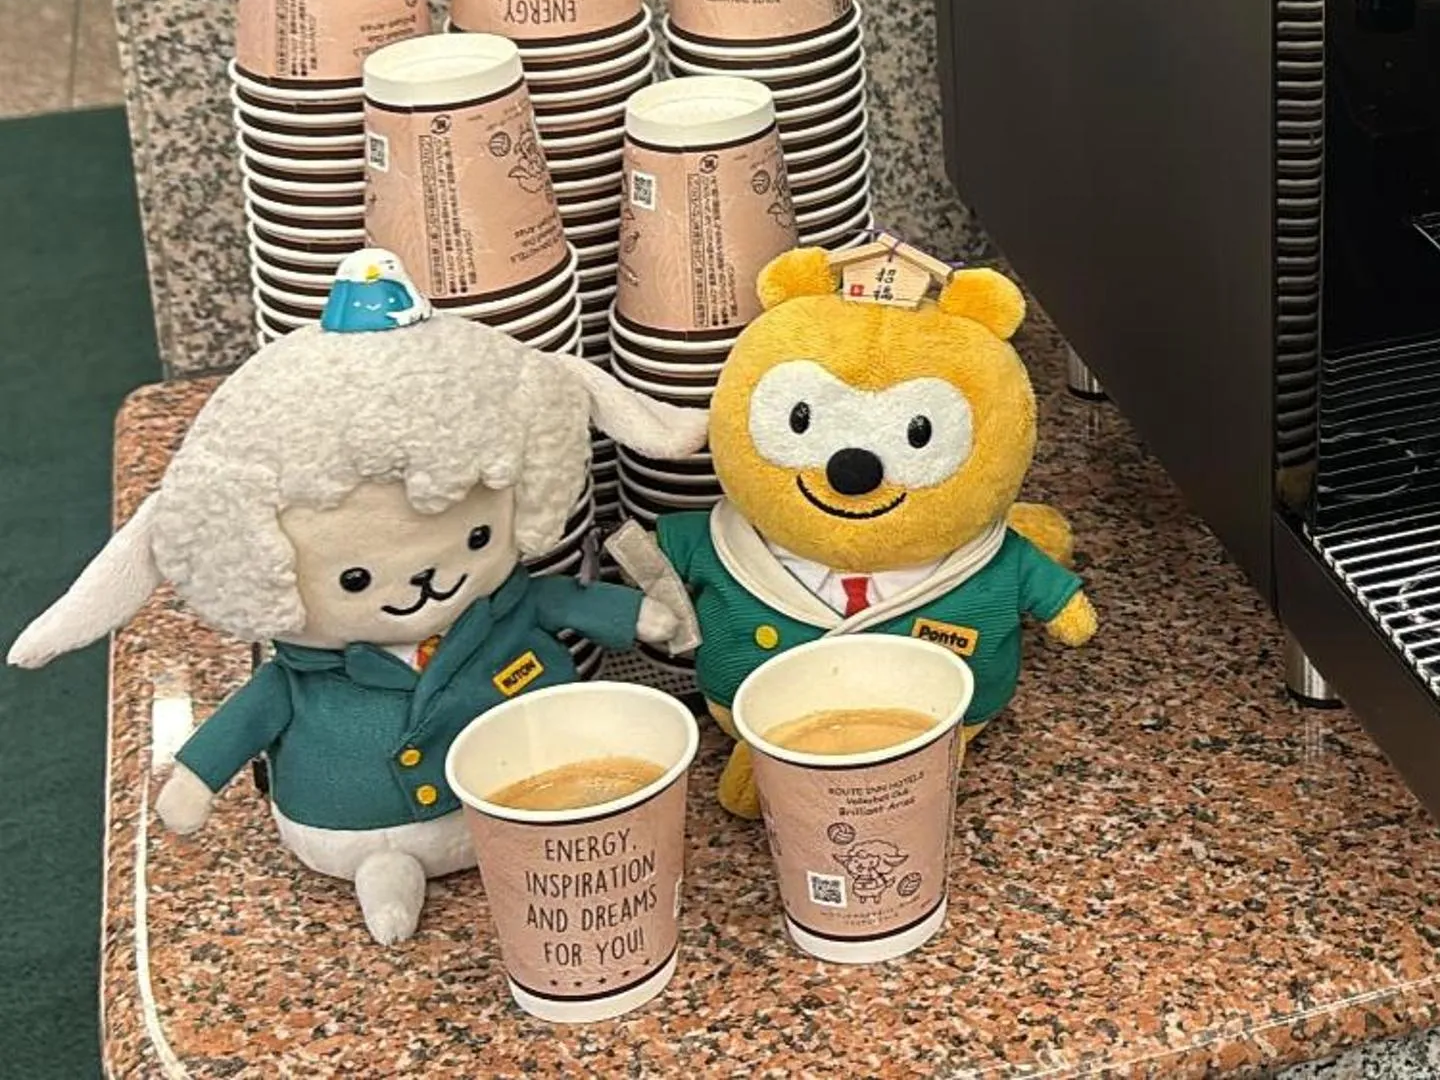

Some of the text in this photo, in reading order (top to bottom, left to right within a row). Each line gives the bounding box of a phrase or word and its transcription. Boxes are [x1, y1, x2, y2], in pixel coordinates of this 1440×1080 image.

[919, 624, 969, 649] Ponta
[525, 849, 656, 900] INSPIRATION
[526, 883, 658, 934] AND DREAMS
[544, 926, 645, 967] FOR YOU!
